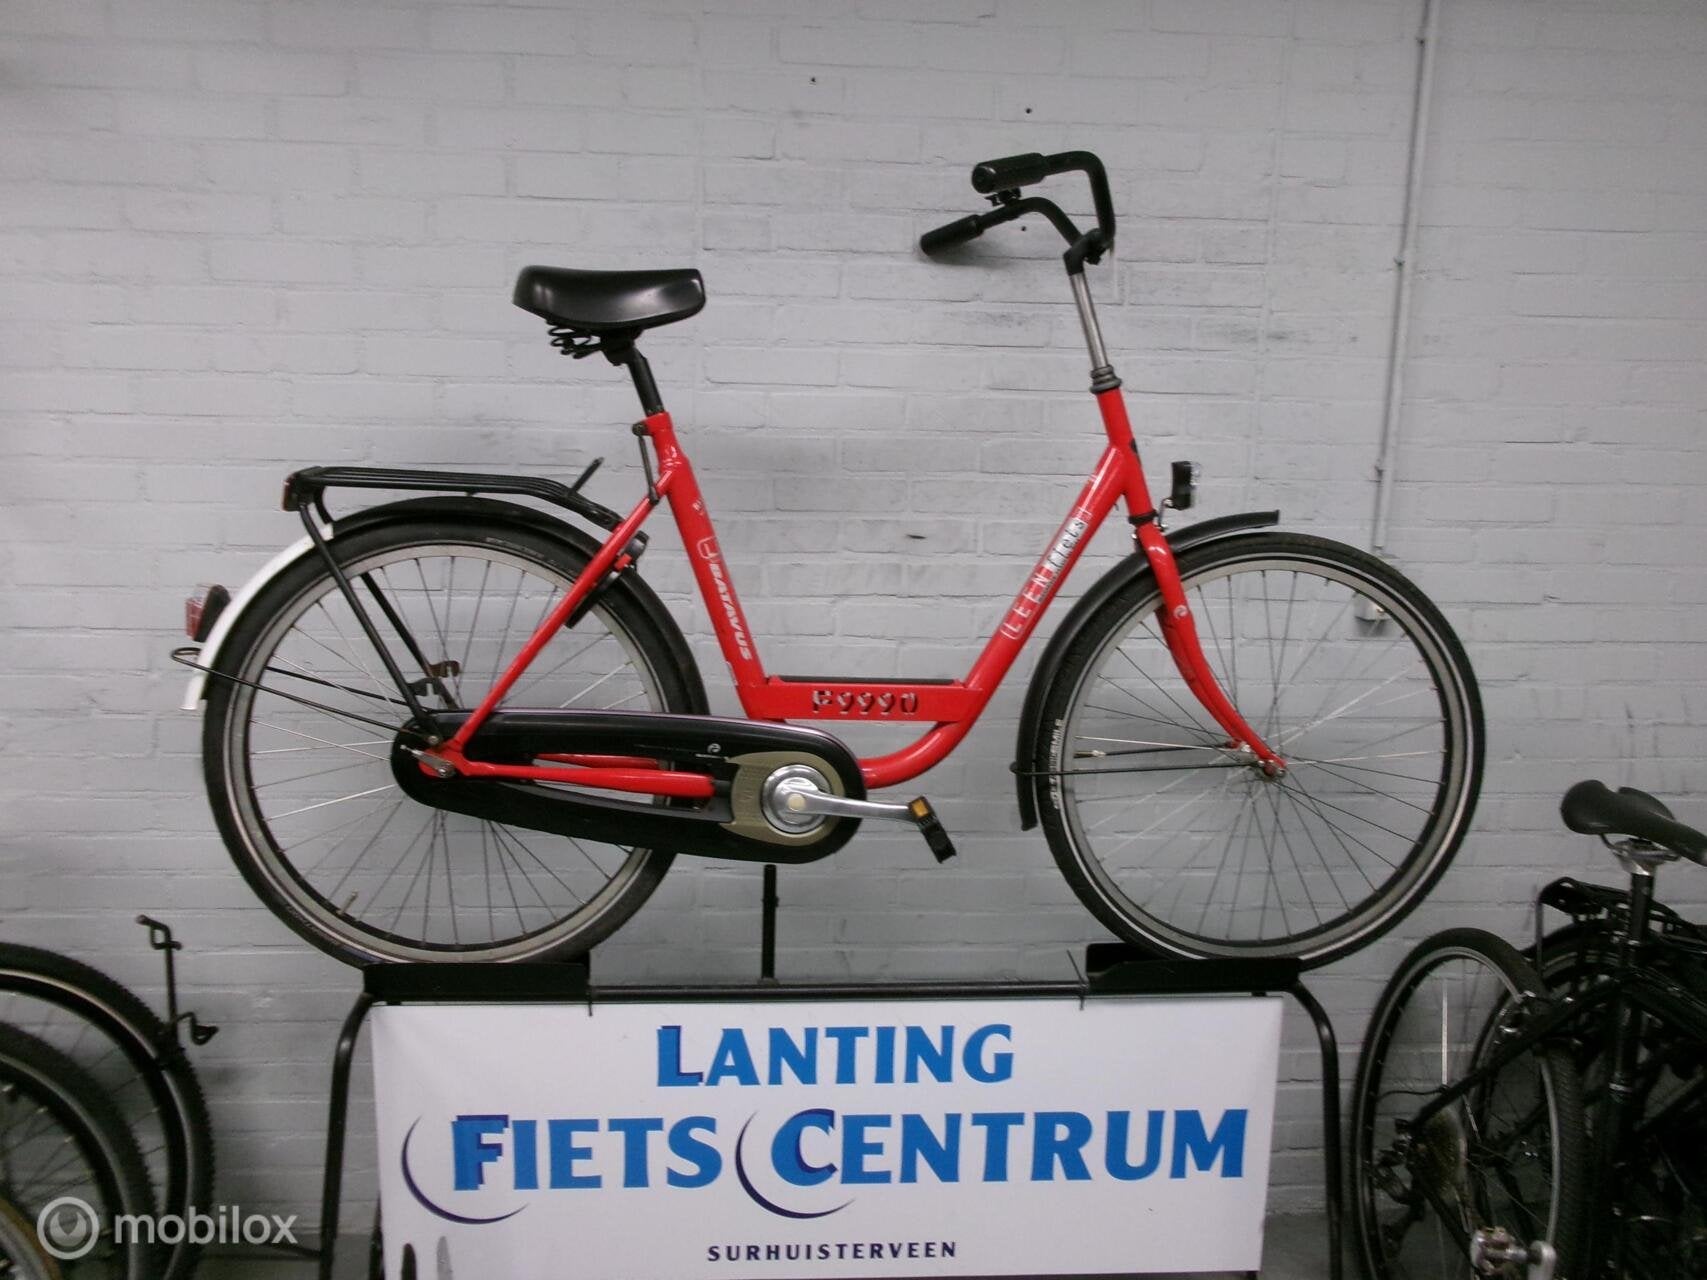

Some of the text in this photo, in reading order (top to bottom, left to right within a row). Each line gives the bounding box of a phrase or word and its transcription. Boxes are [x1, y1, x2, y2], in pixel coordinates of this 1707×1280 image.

[709, 562, 752, 661] BATAVUS
[657, 1024, 1014, 1087] LANTING
[451, 1108, 1248, 1191] FIETS CENTRUM
[707, 1241, 956, 1262] SURHUISTERVEEN
